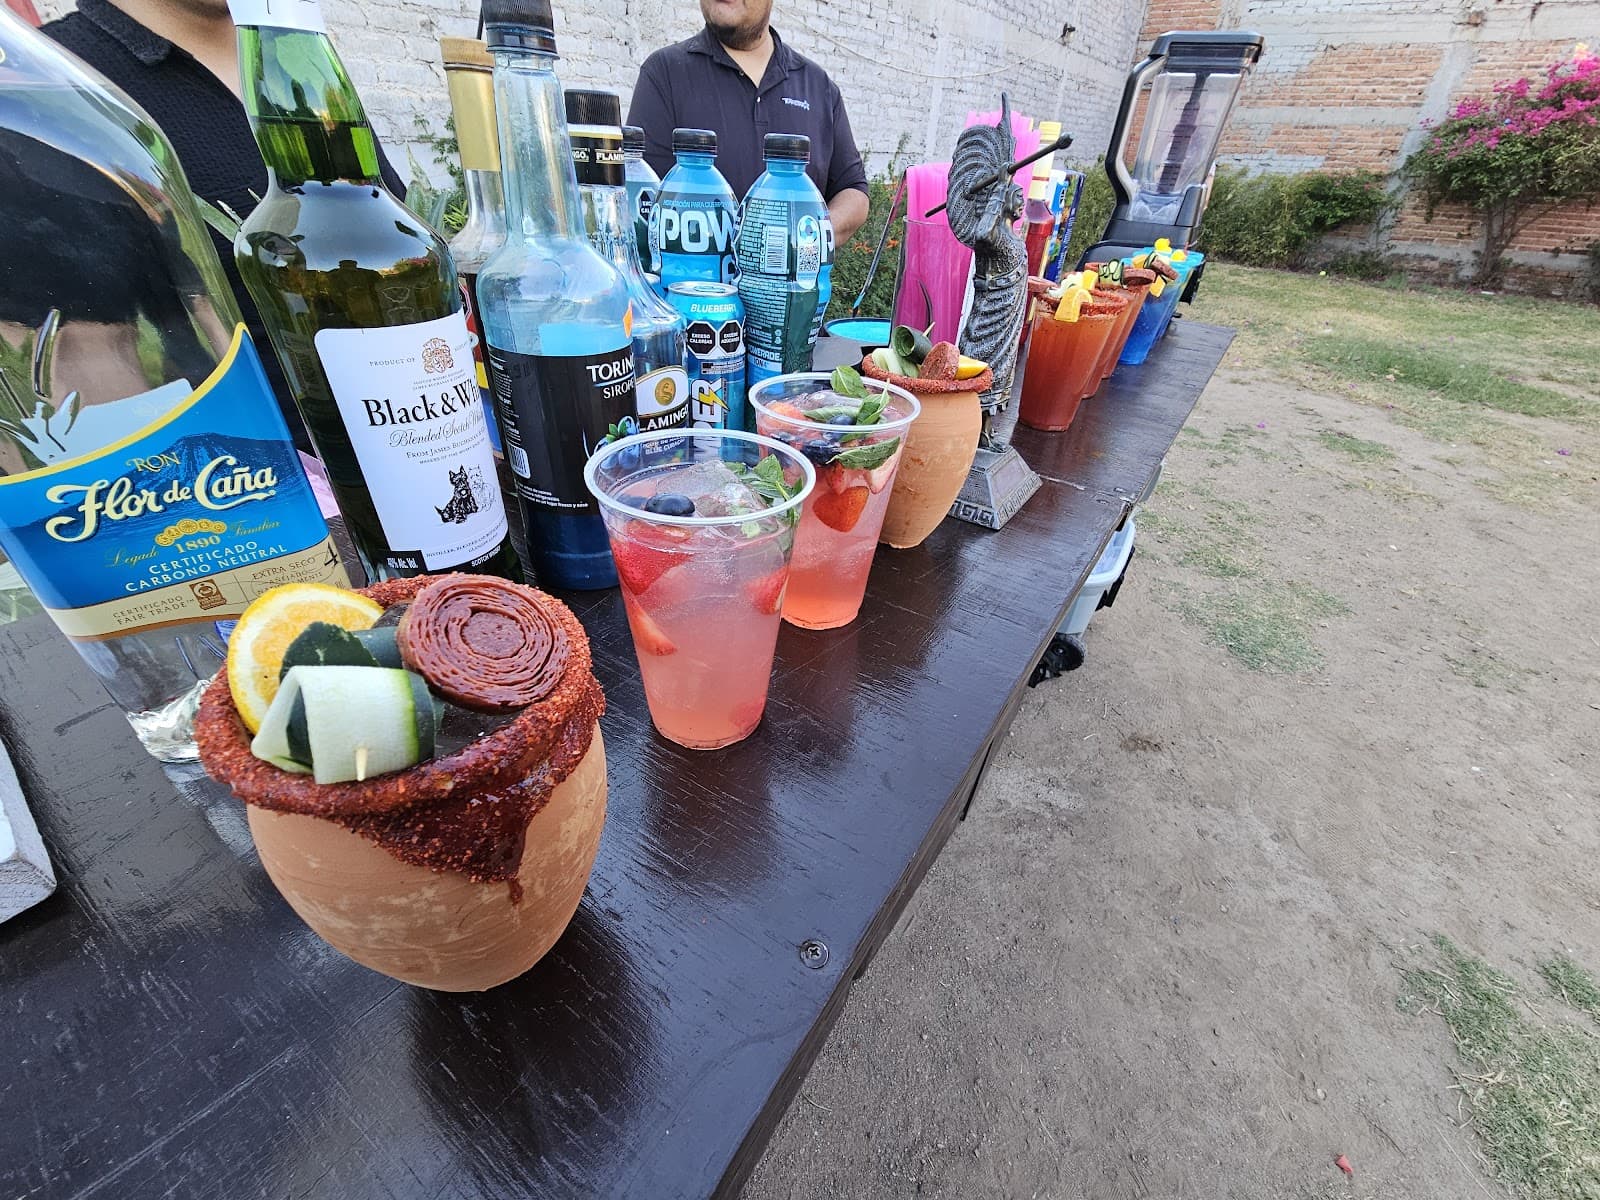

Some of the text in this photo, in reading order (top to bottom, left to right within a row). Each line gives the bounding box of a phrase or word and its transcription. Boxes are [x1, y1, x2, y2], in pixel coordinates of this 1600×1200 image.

[389, 425, 442, 448] Blended
[125, 451, 182, 475] RON
[45, 455, 278, 543] Flor de Caña
[174, 534, 222, 555] 1890
[125, 543, 288, 592] CARBONO NEUTRAL
[148, 540, 258, 575] CERTIFICADO
[251, 556, 316, 581] EXTRA SECO
[113, 595, 183, 619] CERTIFICADO
[116, 612, 145, 625] FAIR
